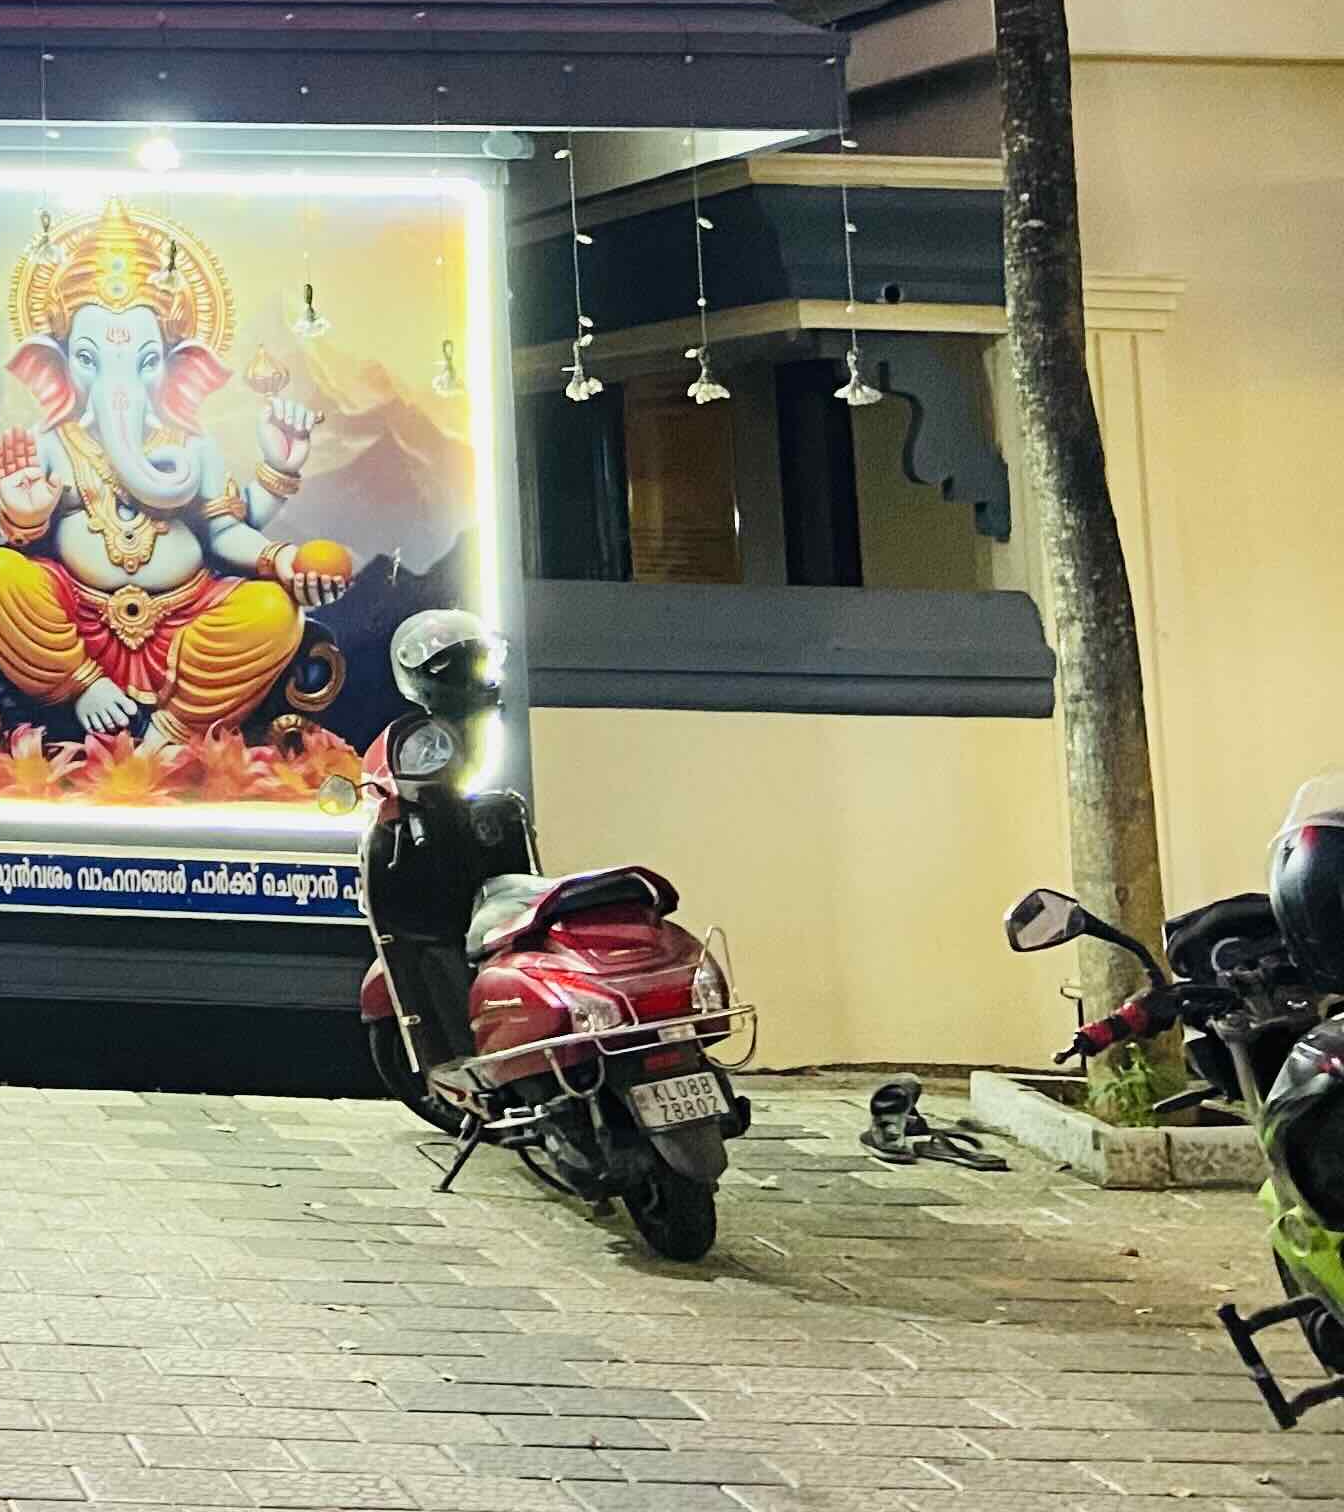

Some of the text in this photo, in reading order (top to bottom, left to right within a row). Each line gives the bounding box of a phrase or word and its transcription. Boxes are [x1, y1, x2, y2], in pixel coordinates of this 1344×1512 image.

[77, 864, 186, 895] വാഹനങ്ങൾ
[191, 864, 259, 896] പാർക്ക്
[262, 868, 338, 905] ചെയ്യാൻ
